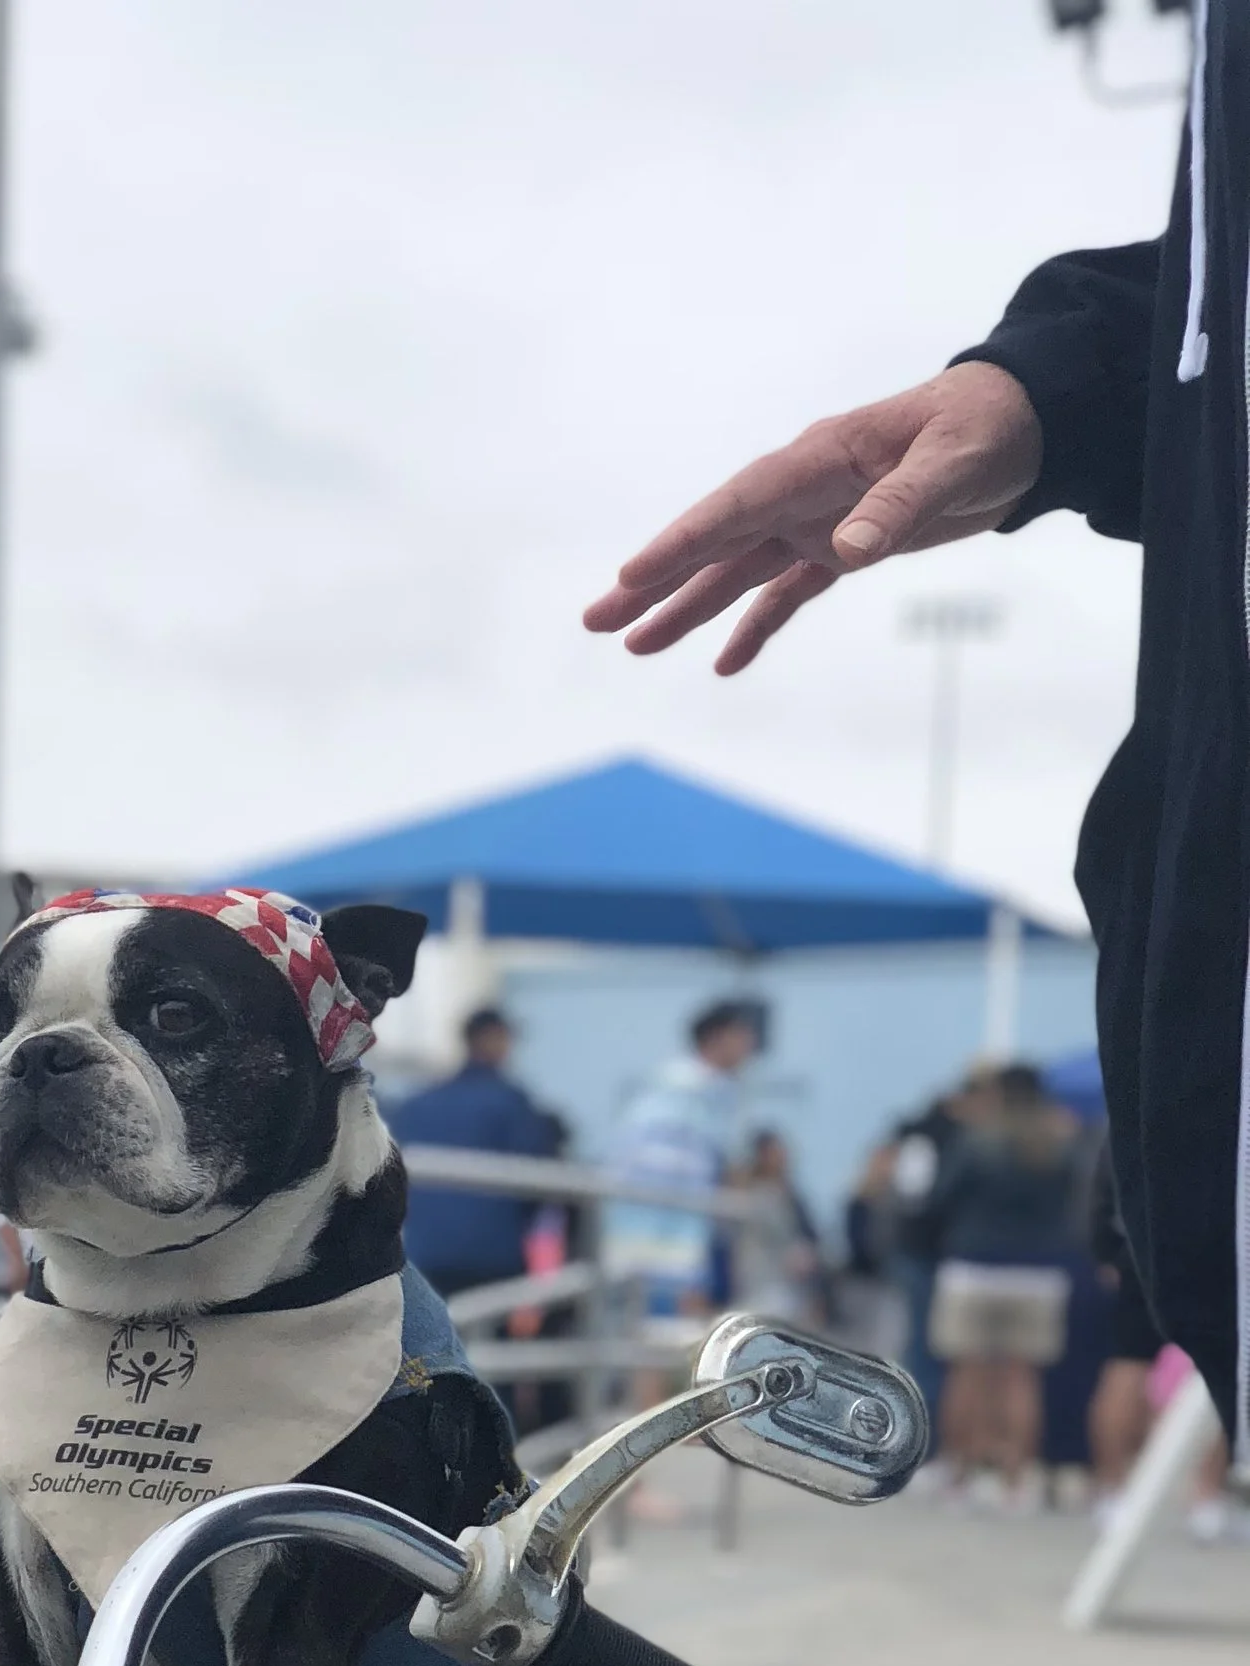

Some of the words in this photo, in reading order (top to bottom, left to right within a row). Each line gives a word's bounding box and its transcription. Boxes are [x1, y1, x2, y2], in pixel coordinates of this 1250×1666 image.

[75, 1414, 202, 1443] Special
[55, 1443, 213, 1474] Olympics
[29, 1472, 122, 1496] Southern
[128, 1479, 226, 1505] Californi
